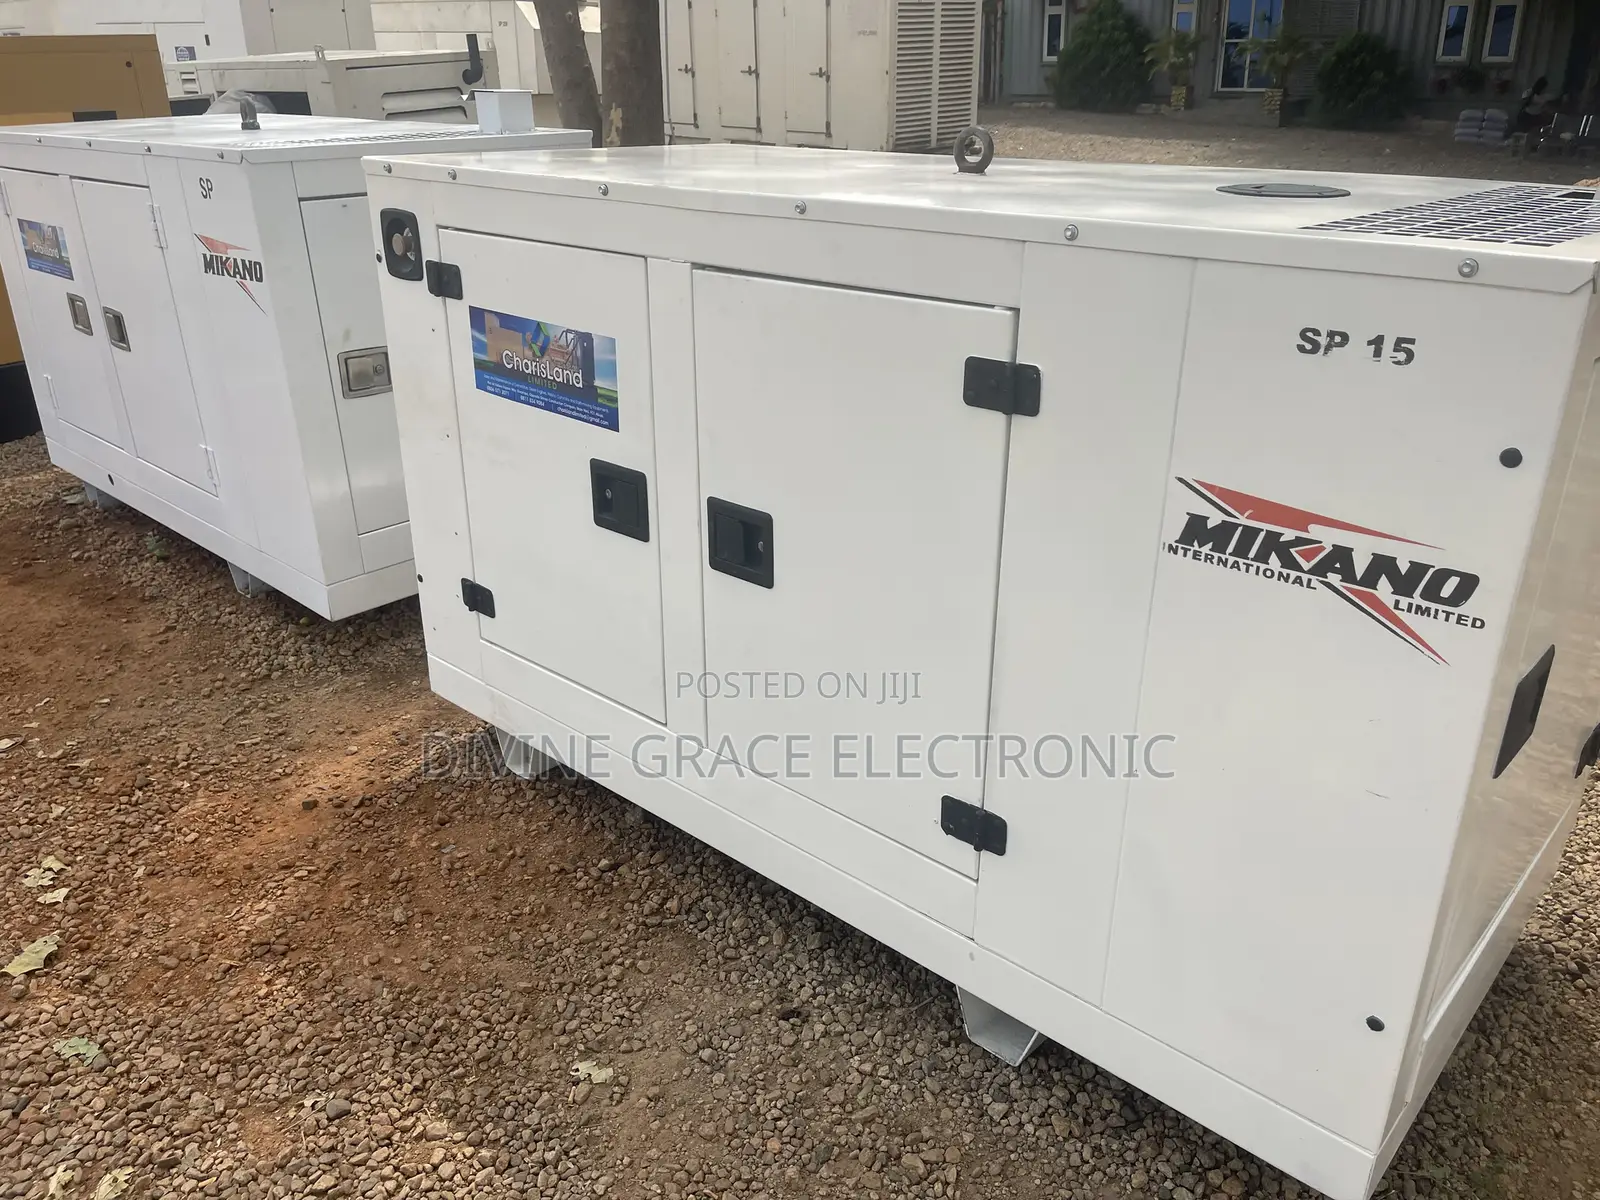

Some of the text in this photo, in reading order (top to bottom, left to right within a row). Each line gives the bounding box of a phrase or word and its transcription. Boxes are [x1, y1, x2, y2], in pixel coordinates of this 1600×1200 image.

[199, 177, 213, 199] SP
[202, 253, 264, 283] MIKANO
[1296, 327, 1417, 366] SP 15
[502, 350, 584, 389] CharisLand
[527, 375, 558, 390] LIMITED
[1162, 542, 1318, 590] INTERNATIONAL
[1174, 511, 1481, 608] MIKANO
[1393, 598, 1486, 630] LIMITED
